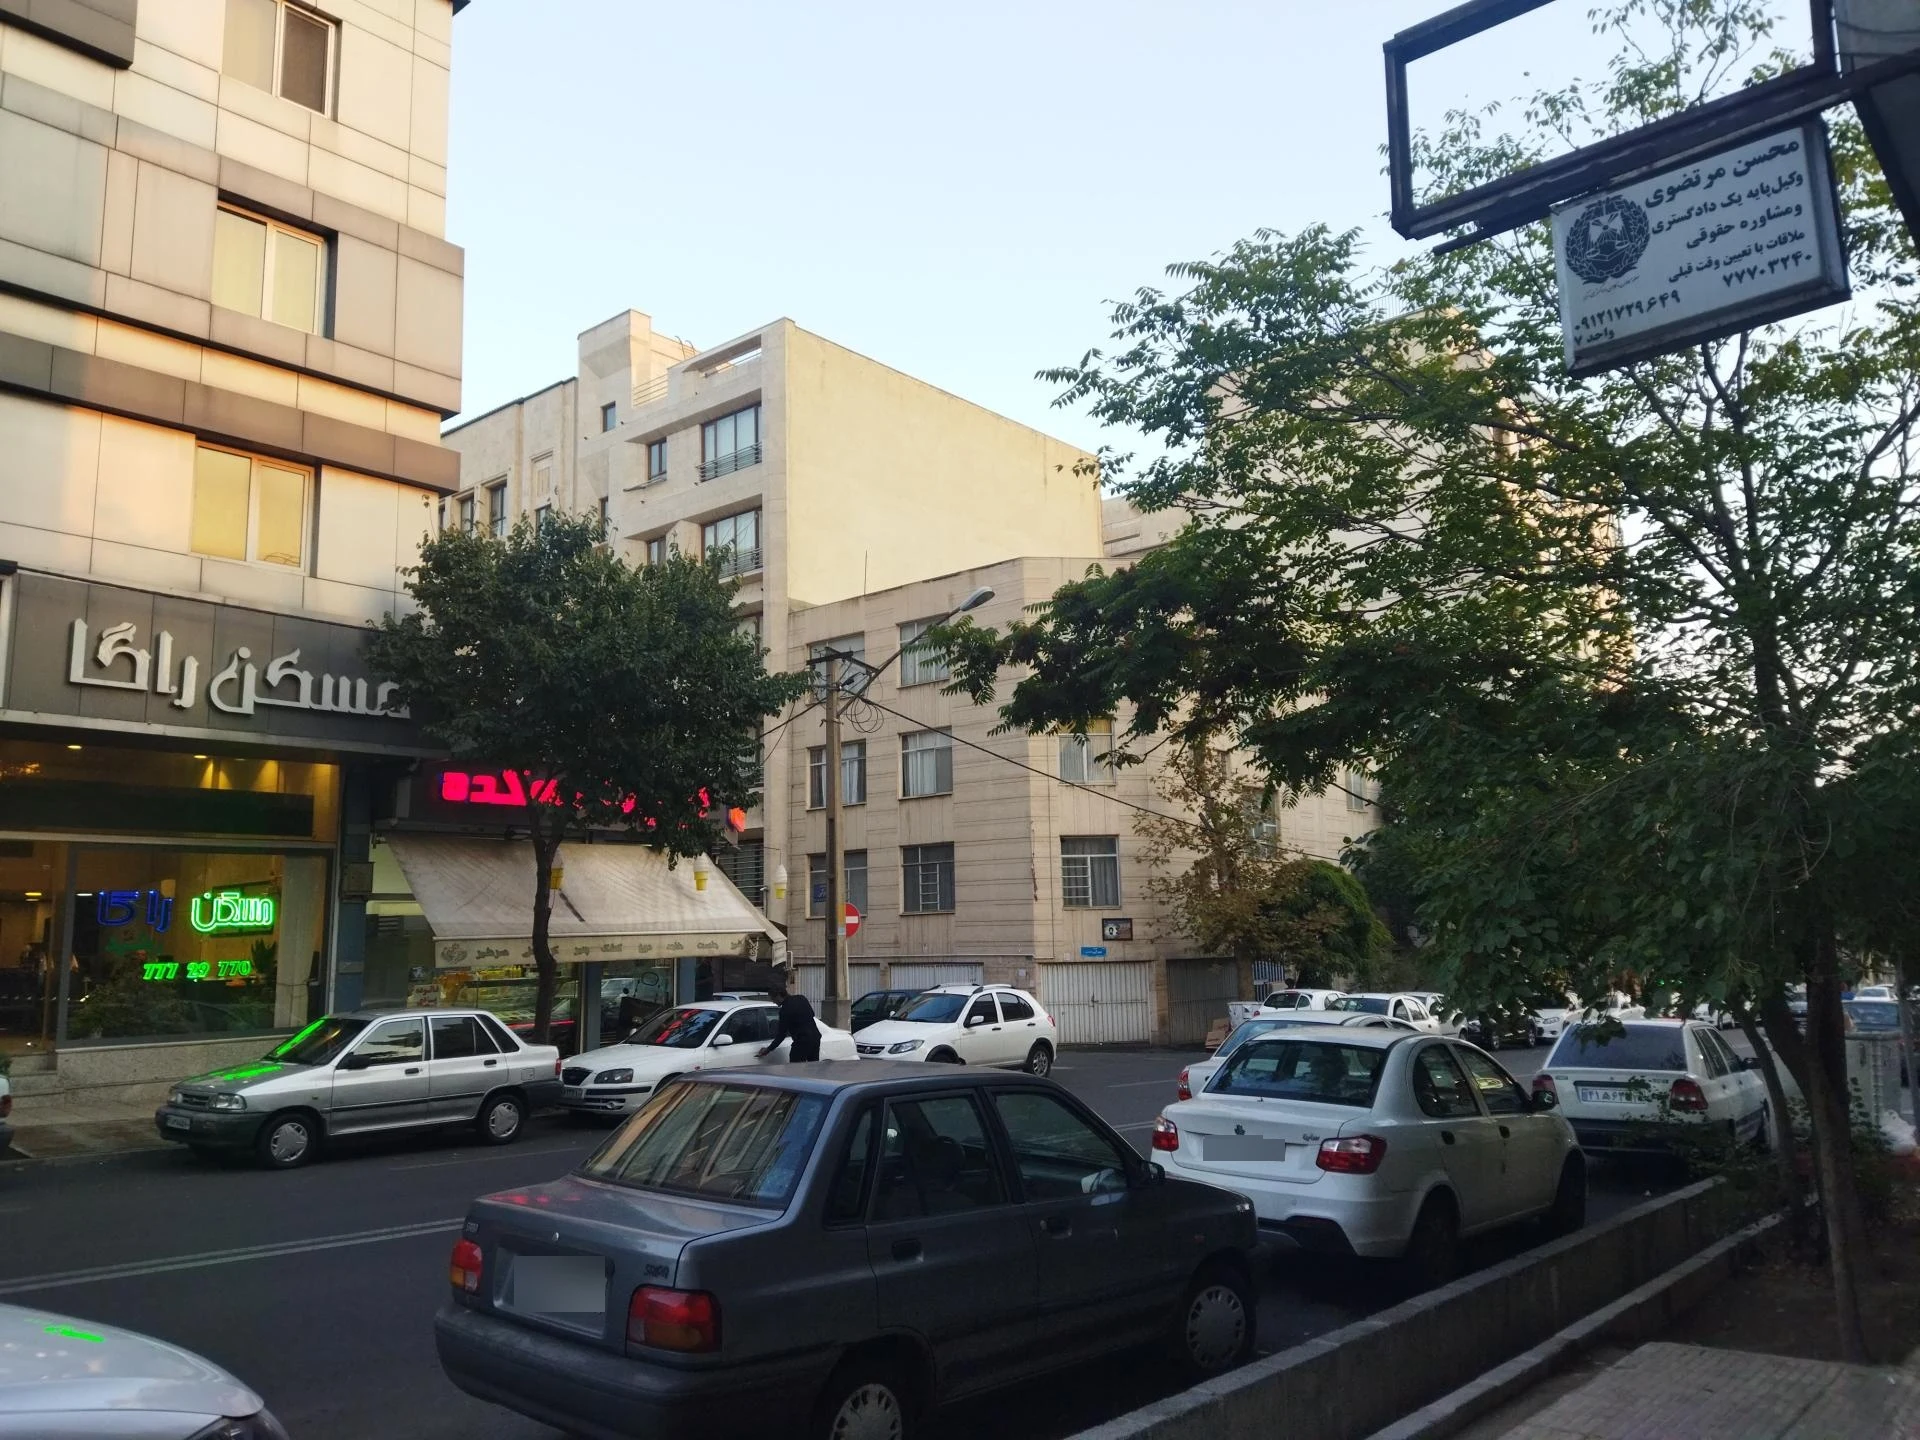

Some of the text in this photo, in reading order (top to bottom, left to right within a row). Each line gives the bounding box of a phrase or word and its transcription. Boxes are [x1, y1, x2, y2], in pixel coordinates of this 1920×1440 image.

[1645, 140, 1800, 208] محسن مرتضوی
[1720, 192, 1743, 208] یک
[1651, 201, 1717, 235] دادگستری
[1686, 223, 1735, 250] حقوقی
[1668, 229, 1805, 283] ملاقات با تعیین وقت قبلی
[1587, 326, 1616, 344] واحد
[210, 647, 411, 719] مسکن
[191, 892, 274, 932] مسکن
[143, 960, 252, 980] 777 29 770
